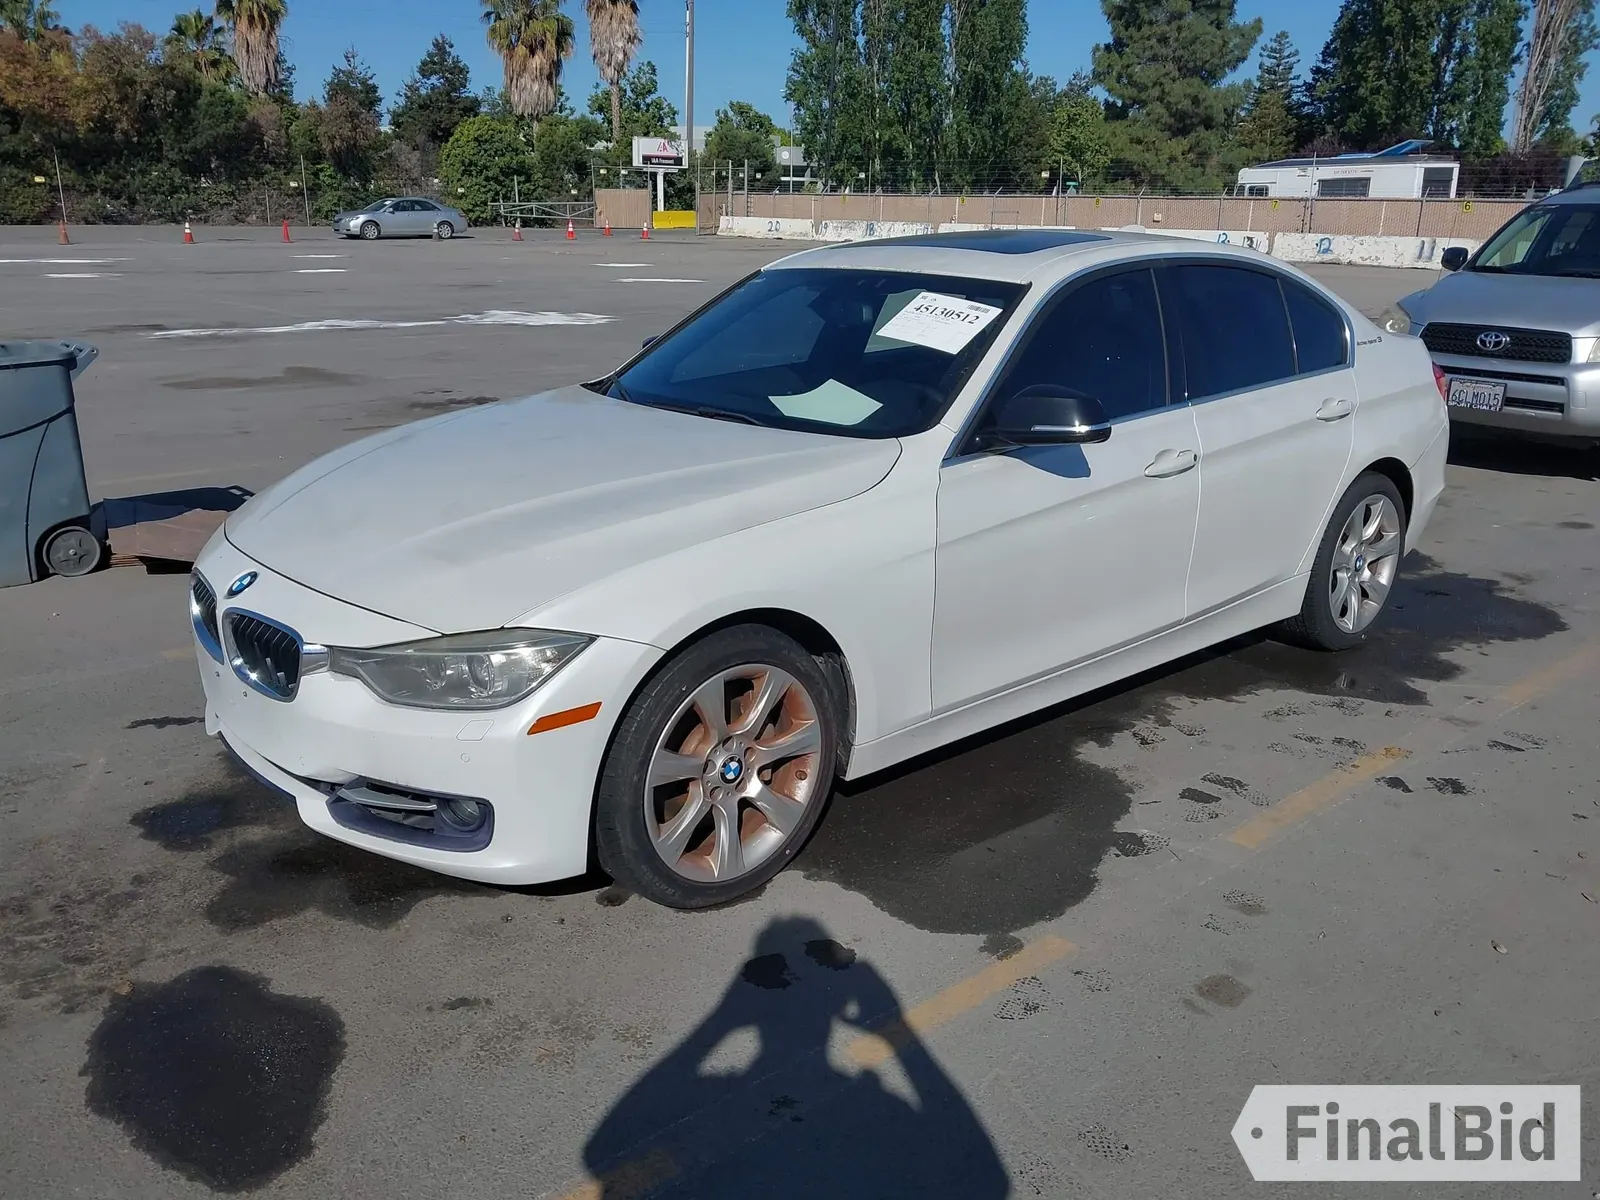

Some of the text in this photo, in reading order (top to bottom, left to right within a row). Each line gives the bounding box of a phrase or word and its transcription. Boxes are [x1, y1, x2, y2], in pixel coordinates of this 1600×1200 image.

[1273, 200, 1279, 210] 7
[1464, 201, 1471, 211] 6
[767, 220, 781, 232] 20
[913, 303, 980, 325] 45130512
[1448, 400, 1501, 412] SPORT CHALET
